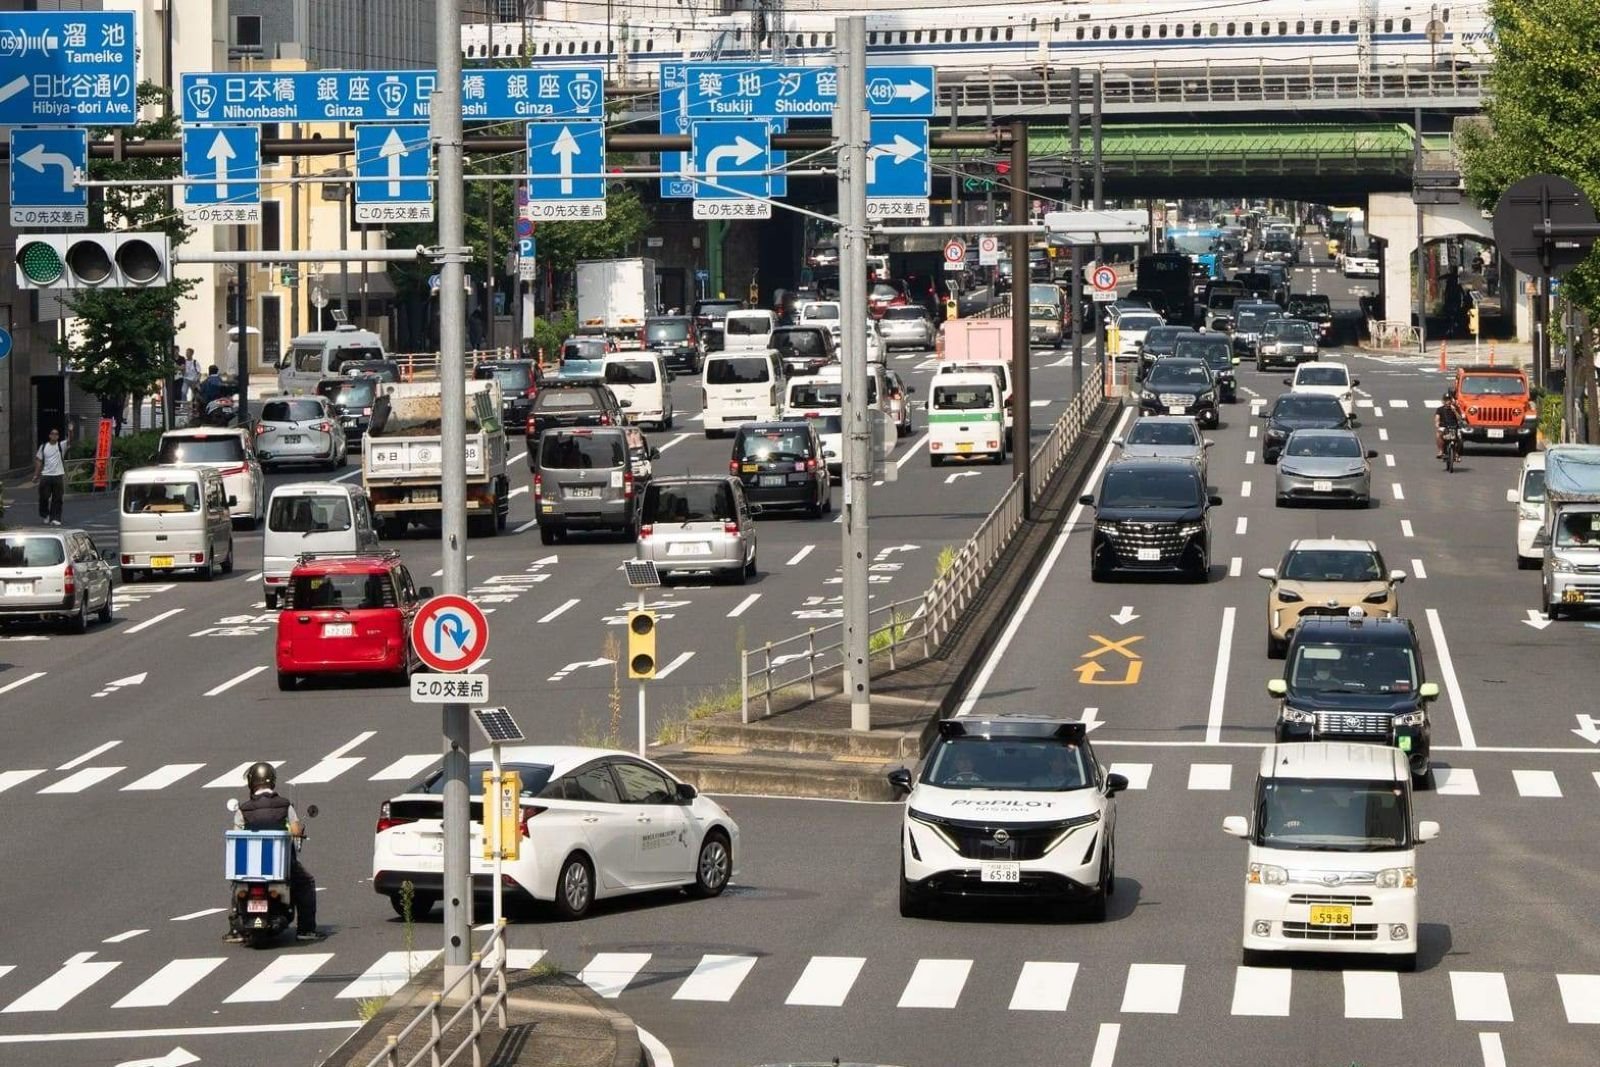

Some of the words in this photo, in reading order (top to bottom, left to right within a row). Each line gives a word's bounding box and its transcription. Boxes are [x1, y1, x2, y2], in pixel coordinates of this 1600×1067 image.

[63, 23, 125, 47] 溜池
[66, 50, 123, 63] Tameike
[33, 74, 130, 98] 日比谷通り
[225, 78, 295, 102] 日本橋
[316, 76, 370, 101] 銀座
[416, 75, 486, 99] 日橋
[506, 75, 560, 99] 銀座
[574, 83, 591, 99] 15
[698, 72, 761, 97] 築地
[777, 72, 837, 96] 汐留
[871, 85, 892, 97] 481
[194, 88, 211, 104] 15
[384, 86, 402, 102] 15
[32, 101, 101, 116] Hibiya-dori
[105, 102, 131, 114] Ave.
[223, 105, 298, 118] Nihonbashi
[324, 104, 363, 117] Ginza
[413, 102, 488, 116] Niashi
[515, 102, 553, 115] Ginza
[708, 100, 753, 115] Tsukiji
[187, 209, 259, 221] この先交差点
[359, 206, 431, 219] この先交差点
[531, 204, 603, 217] この先交差点
[697, 203, 768, 216] この先交差点
[867, 202, 927, 215] の先交差点
[14, 210, 85, 223] この先交差点
[416, 680, 484, 698] この交差点
[1319, 913, 1350, 924] 59-89
